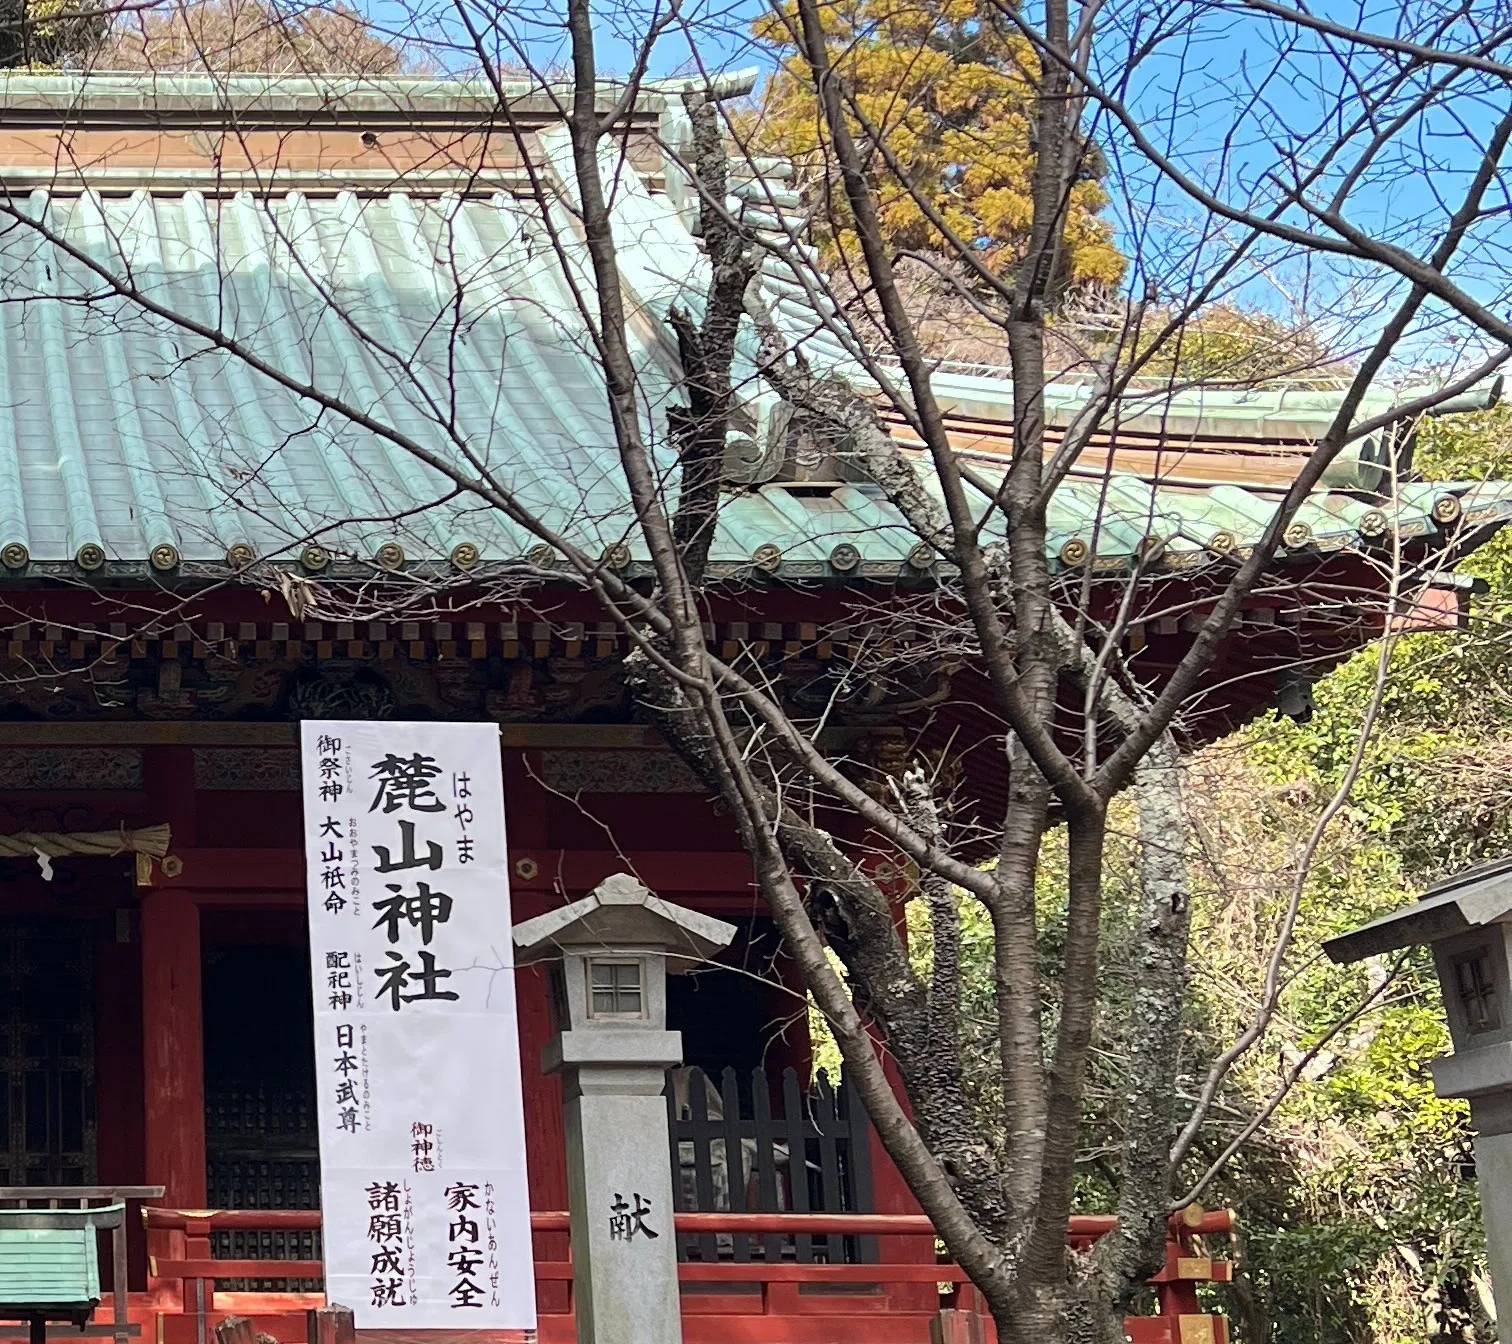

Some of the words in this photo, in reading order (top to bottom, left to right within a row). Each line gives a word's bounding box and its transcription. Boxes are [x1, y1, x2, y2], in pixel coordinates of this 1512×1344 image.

[316, 734, 343, 803] 御祭神
[453, 771, 475, 864] はやま
[348, 816, 360, 916] おおやまつみのみこと
[368, 752, 459, 1011] 麓山神社
[326, 951, 352, 1010] 配祀神
[334, 1023, 362, 1133] 日本武尊
[410, 1121, 435, 1173] 御神徳
[364, 1181, 407, 1309] 諸願成就
[444, 1181, 487, 1309] 家内安全
[484, 1179, 500, 1308] かないあんぜん
